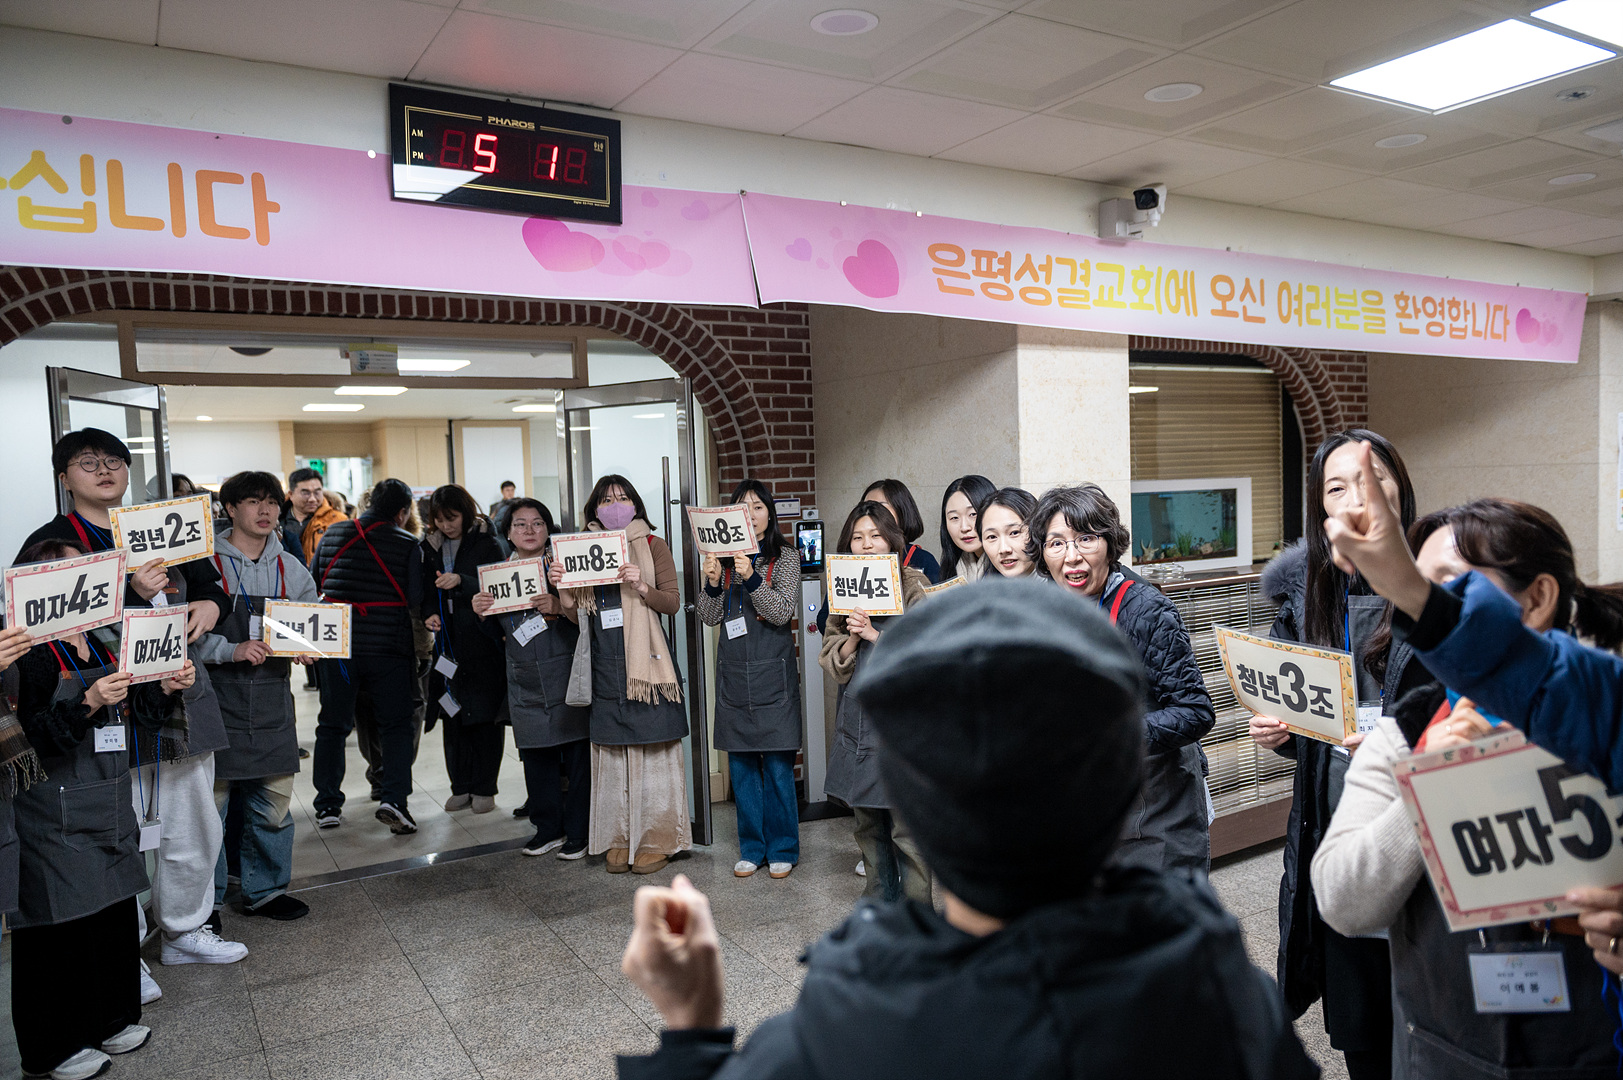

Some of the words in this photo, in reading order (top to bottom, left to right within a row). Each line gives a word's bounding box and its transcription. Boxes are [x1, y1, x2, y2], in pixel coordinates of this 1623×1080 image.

[411, 129, 424, 138] AM
[487, 115, 535, 130] PHAROS
[412, 151, 424, 160] PM
[0, 150, 281, 246] 십니다
[927, 243, 1198, 317] 은평성결교회에
[1210, 274, 1266, 324] 오신
[1277, 280, 1386, 335] 여러분을
[1393, 290, 1510, 342] 환영합니다
[127, 512, 202, 553] 청년2조
[697, 518, 745, 545] 여자8조
[564, 544, 619, 573] 여자8조
[25, 573, 110, 627] 여자4조
[488, 571, 538, 600] 여자1조
[834, 566, 890, 599] 청년4조
[133, 623, 182, 665] 여자4조
[1236, 661, 1335, 720] 청년3조
[1451, 763, 1623, 876] 여자5
